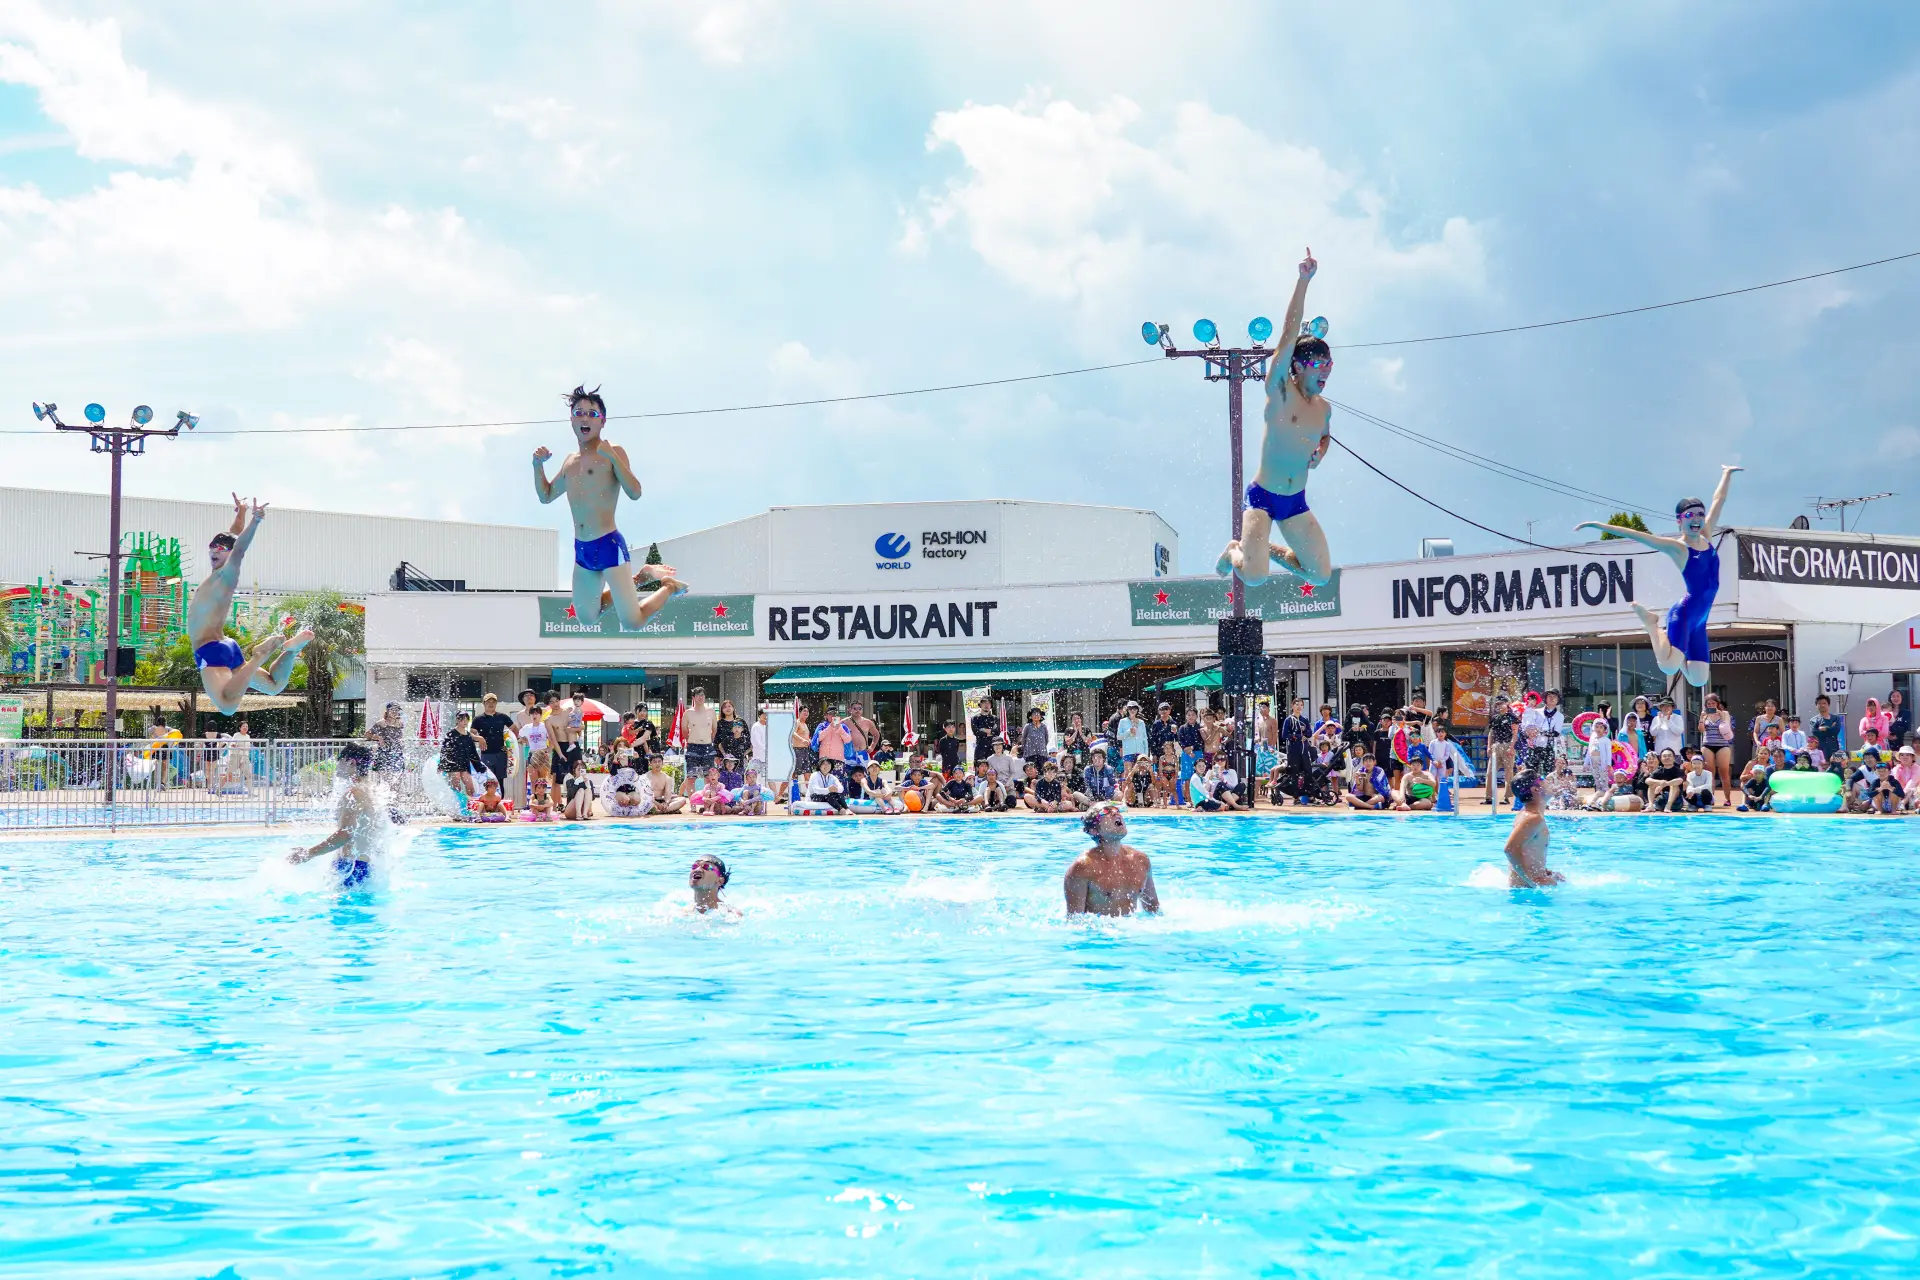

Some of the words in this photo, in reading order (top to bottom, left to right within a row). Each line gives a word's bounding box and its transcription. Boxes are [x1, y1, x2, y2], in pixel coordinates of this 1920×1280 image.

[922, 531, 987, 545] FASHION
[922, 547, 967, 560] factory
[876, 562, 911, 570] WORLD
[1751, 543, 1920, 583] INFORMATION
[1393, 559, 1634, 619] INFORMATION
[1207, 607, 1263, 619] Heinen
[1280, 600, 1336, 614] Heineken
[1136, 608, 1191, 620] Heineken
[693, 621, 748, 632] Heineken
[769, 601, 998, 641] RESTAURANT
[1711, 650, 1782, 662] INFORMATION
